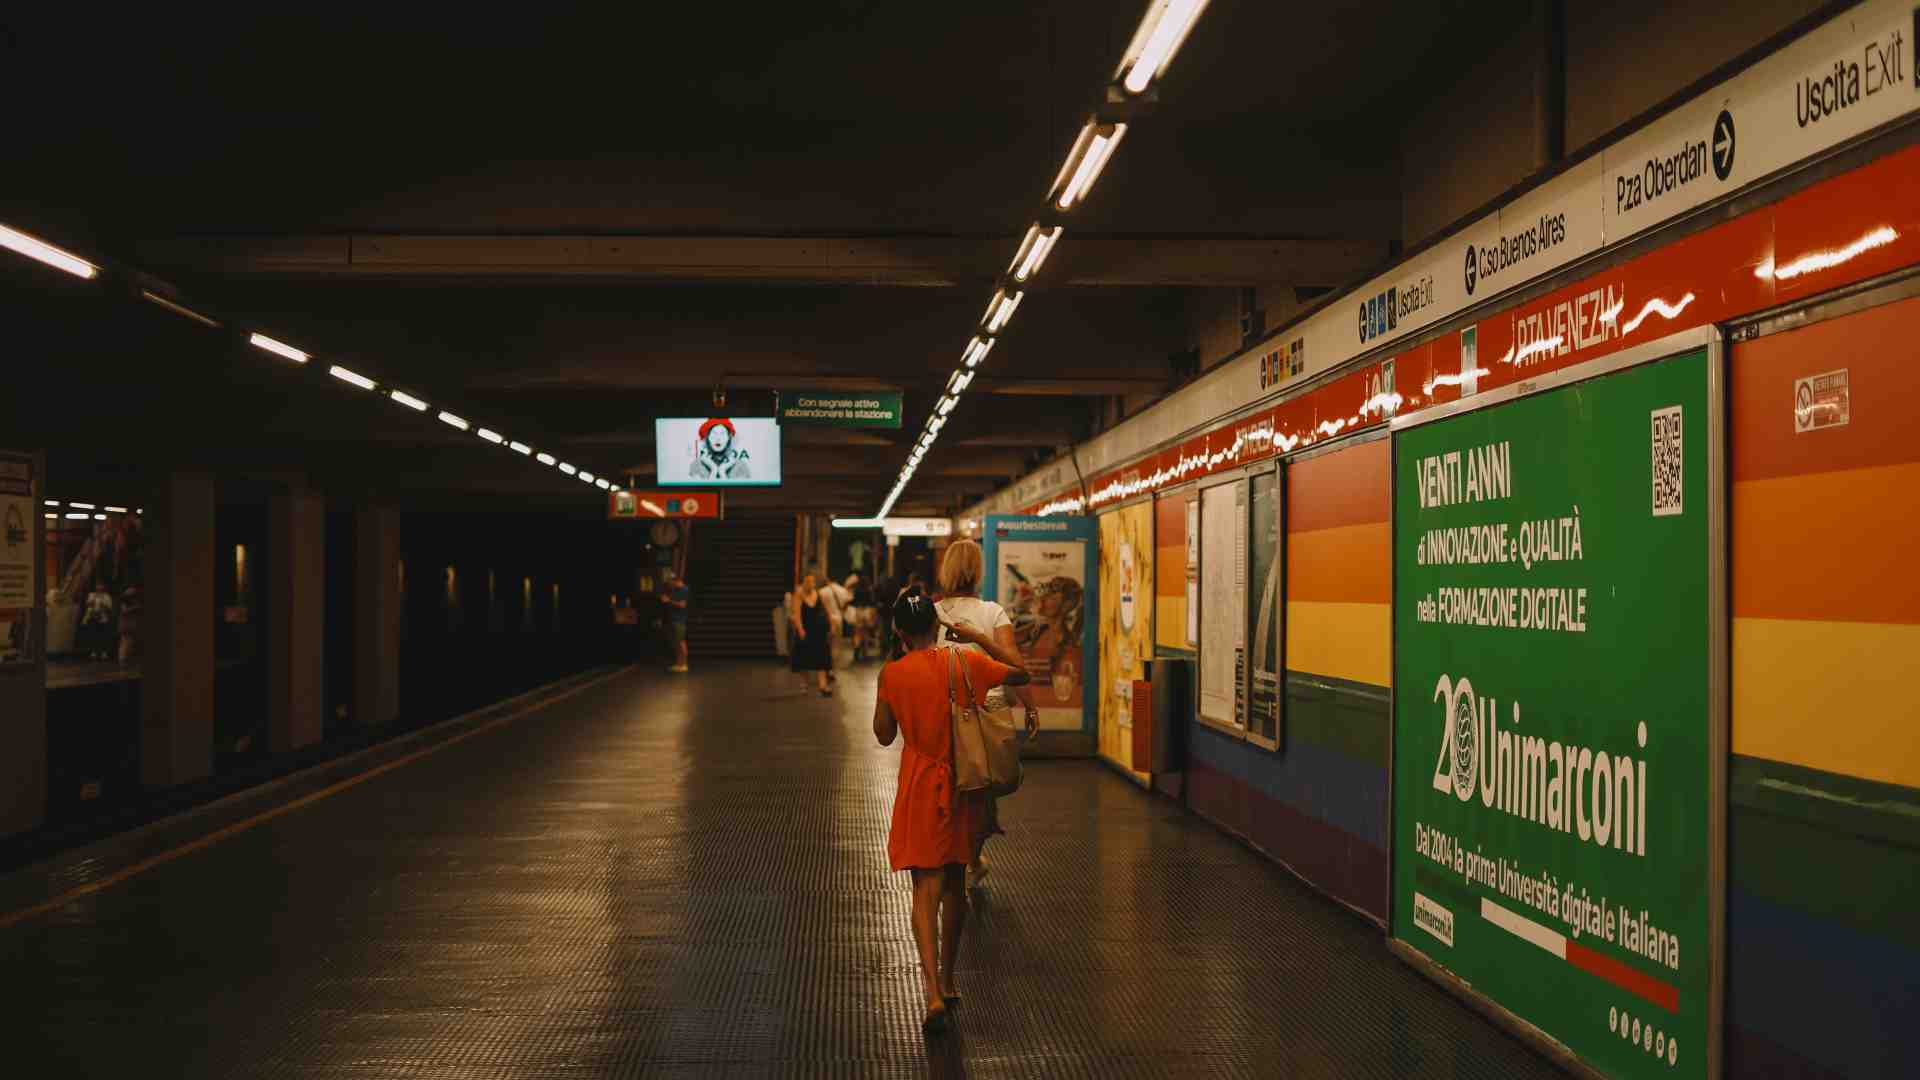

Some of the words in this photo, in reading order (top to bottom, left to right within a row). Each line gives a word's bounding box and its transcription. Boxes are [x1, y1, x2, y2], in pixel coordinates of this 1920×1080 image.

[1796, 60, 1860, 128] Uscita
[1865, 31, 1904, 97] Exit
[1617, 175, 1641, 215] P.za
[1644, 139, 1707, 201] Oberdan
[1479, 246, 1499, 280] C.so
[1499, 227, 1537, 270] Buenos
[1538, 212, 1566, 250] Aires
[1397, 285, 1420, 318] Uscita
[1420, 276, 1434, 308] Exit
[1547, 284, 1619, 358] VENEZIA
[799, 398, 817, 408] Con
[818, 399, 853, 409] segnale
[854, 399, 880, 409] attivo
[854, 409, 893, 419] stazione
[1416, 450, 1462, 509] VENTI
[1466, 441, 1511, 503] ANNI
[1417, 536, 1426, 565] di
[1427, 523, 1508, 566] INNOVAZIONE
[1510, 538, 1518, 562] e
[1519, 505, 1583, 571] QUALITÀ
[1417, 593, 1437, 623] nella
[1438, 587, 1517, 628] FORMAZIONE
[1520, 588, 1587, 633] DIGITALE
[1479, 696, 1648, 857] Unimarconi
[1416, 821, 1430, 857] Dal
[1431, 827, 1453, 869] 2004
[1454, 836, 1464, 874] la
[1465, 844, 1496, 888] prima
[1498, 857, 1560, 918] Università
[1561, 881, 1616, 942] digitale
[1619, 905, 1679, 970] Italiana
